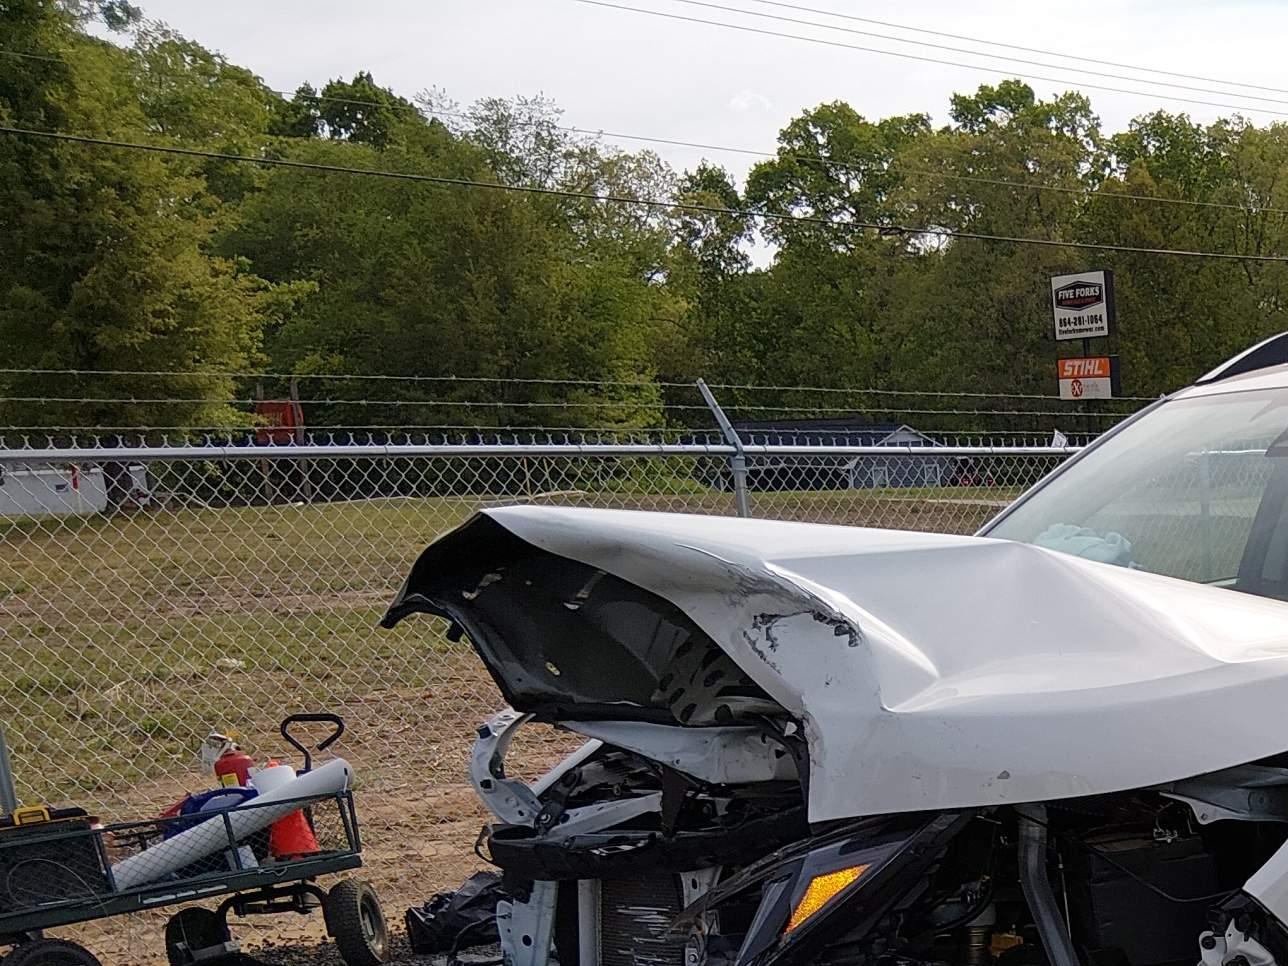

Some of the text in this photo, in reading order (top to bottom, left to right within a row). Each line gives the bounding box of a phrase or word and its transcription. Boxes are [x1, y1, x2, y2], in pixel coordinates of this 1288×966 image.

[1058, 286, 1100, 300] FIVE FORKS
[1059, 314, 1103, 328] 864-281-1064
[1063, 359, 1103, 376] STIHL
